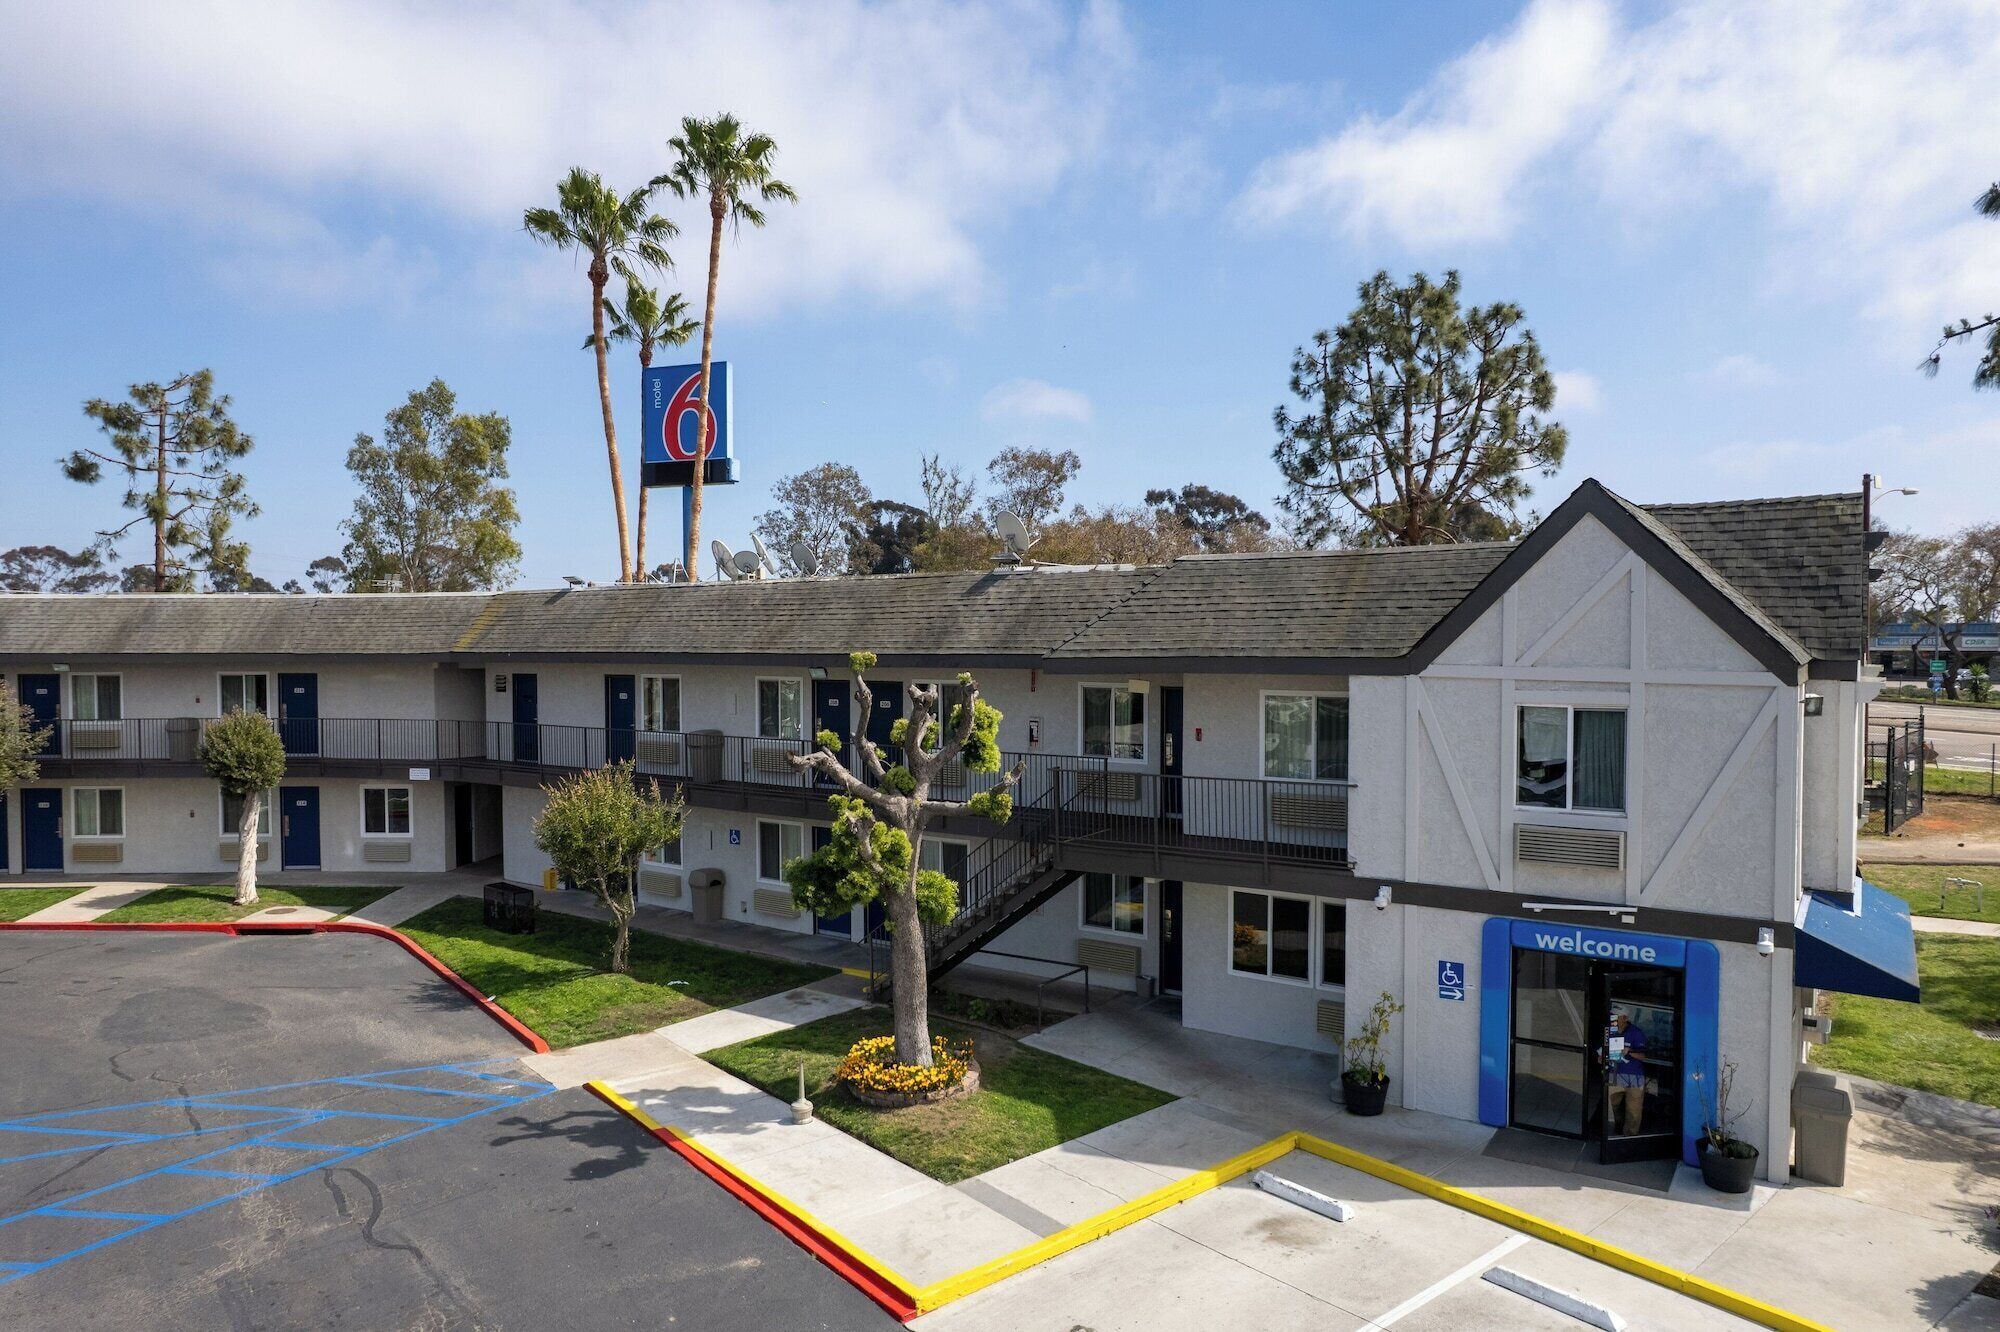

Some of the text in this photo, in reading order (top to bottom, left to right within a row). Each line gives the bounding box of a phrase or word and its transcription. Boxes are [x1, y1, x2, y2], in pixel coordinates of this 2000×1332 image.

[652, 378, 662, 409] motel
[662, 370, 718, 462] 6
[1535, 931, 1657, 962] welcome
